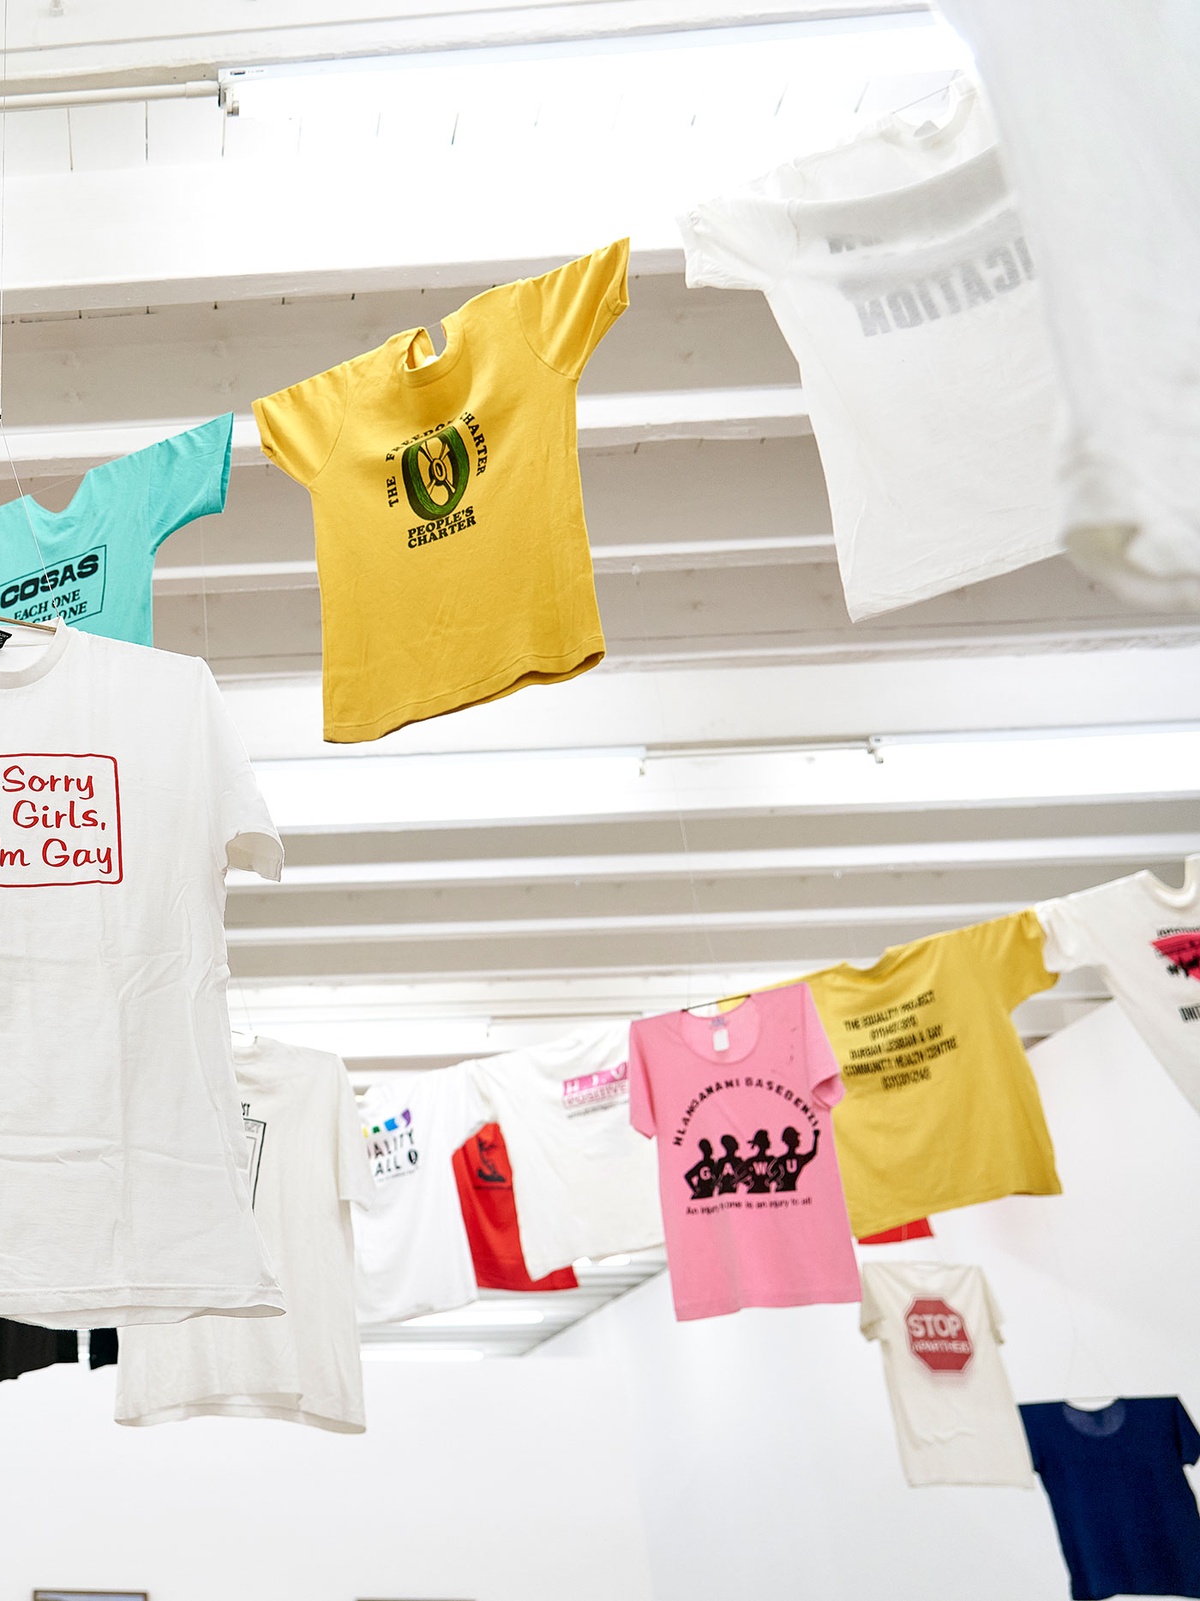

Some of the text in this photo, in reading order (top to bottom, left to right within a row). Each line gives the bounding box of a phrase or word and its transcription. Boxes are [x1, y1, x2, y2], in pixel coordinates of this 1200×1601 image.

[386, 475, 400, 508] THE
[407, 505, 475, 539] PEOPLE'S
[407, 515, 477, 549] CHARTER
[0, 554, 99, 609] COSAS
[14, 600, 49, 621] EACH
[51, 589, 81, 609] ONE
[56, 601, 88, 621] ONE
[2, 765, 94, 800] Sorry
[12, 800, 106, 831] Girls,
[41, 838, 113, 875] Gay
[673, 1078, 741, 1147] HLANGANANI
[908, 1313, 961, 1339] STOP
